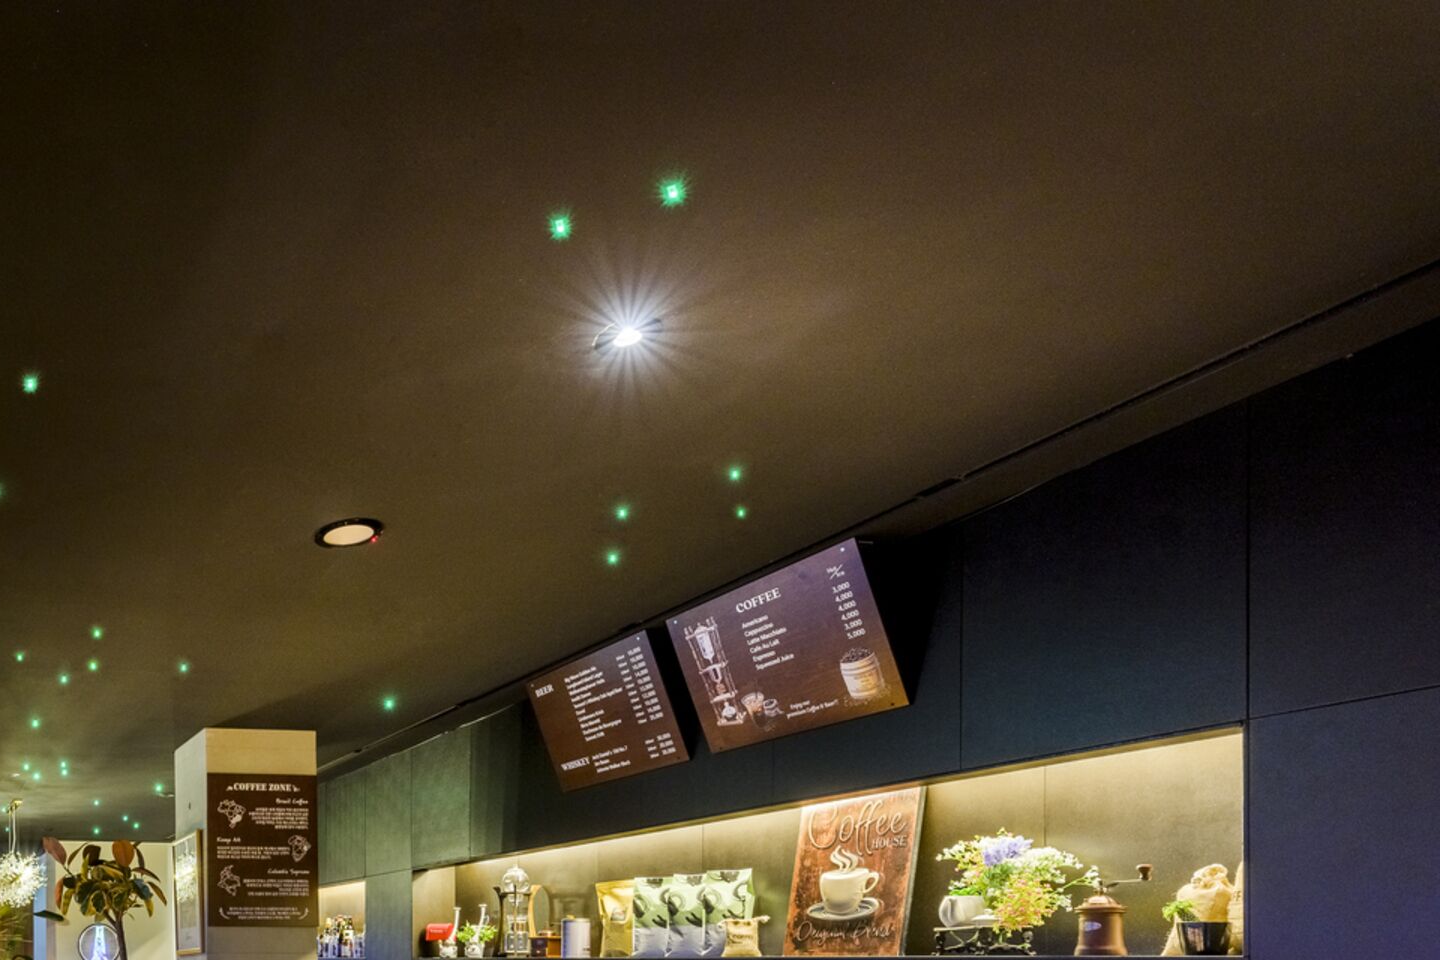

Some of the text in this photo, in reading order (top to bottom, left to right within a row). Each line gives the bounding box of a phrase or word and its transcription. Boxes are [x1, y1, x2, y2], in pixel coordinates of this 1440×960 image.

[736, 587, 781, 613] COFFEE
[835, 591, 853, 603] 4,000
[742, 615, 769, 629] Americano
[841, 609, 859, 621] 4,000
[747, 636, 760, 646] Latte
[838, 600, 856, 612] 4,000
[535, 684, 554, 697] BEER
[561, 756, 590, 771] WHISKEY
[233, 782, 292, 792] COFFEE ZONE
[809, 801, 906, 856] Coffee
[872, 835, 907, 850] HOUSE
